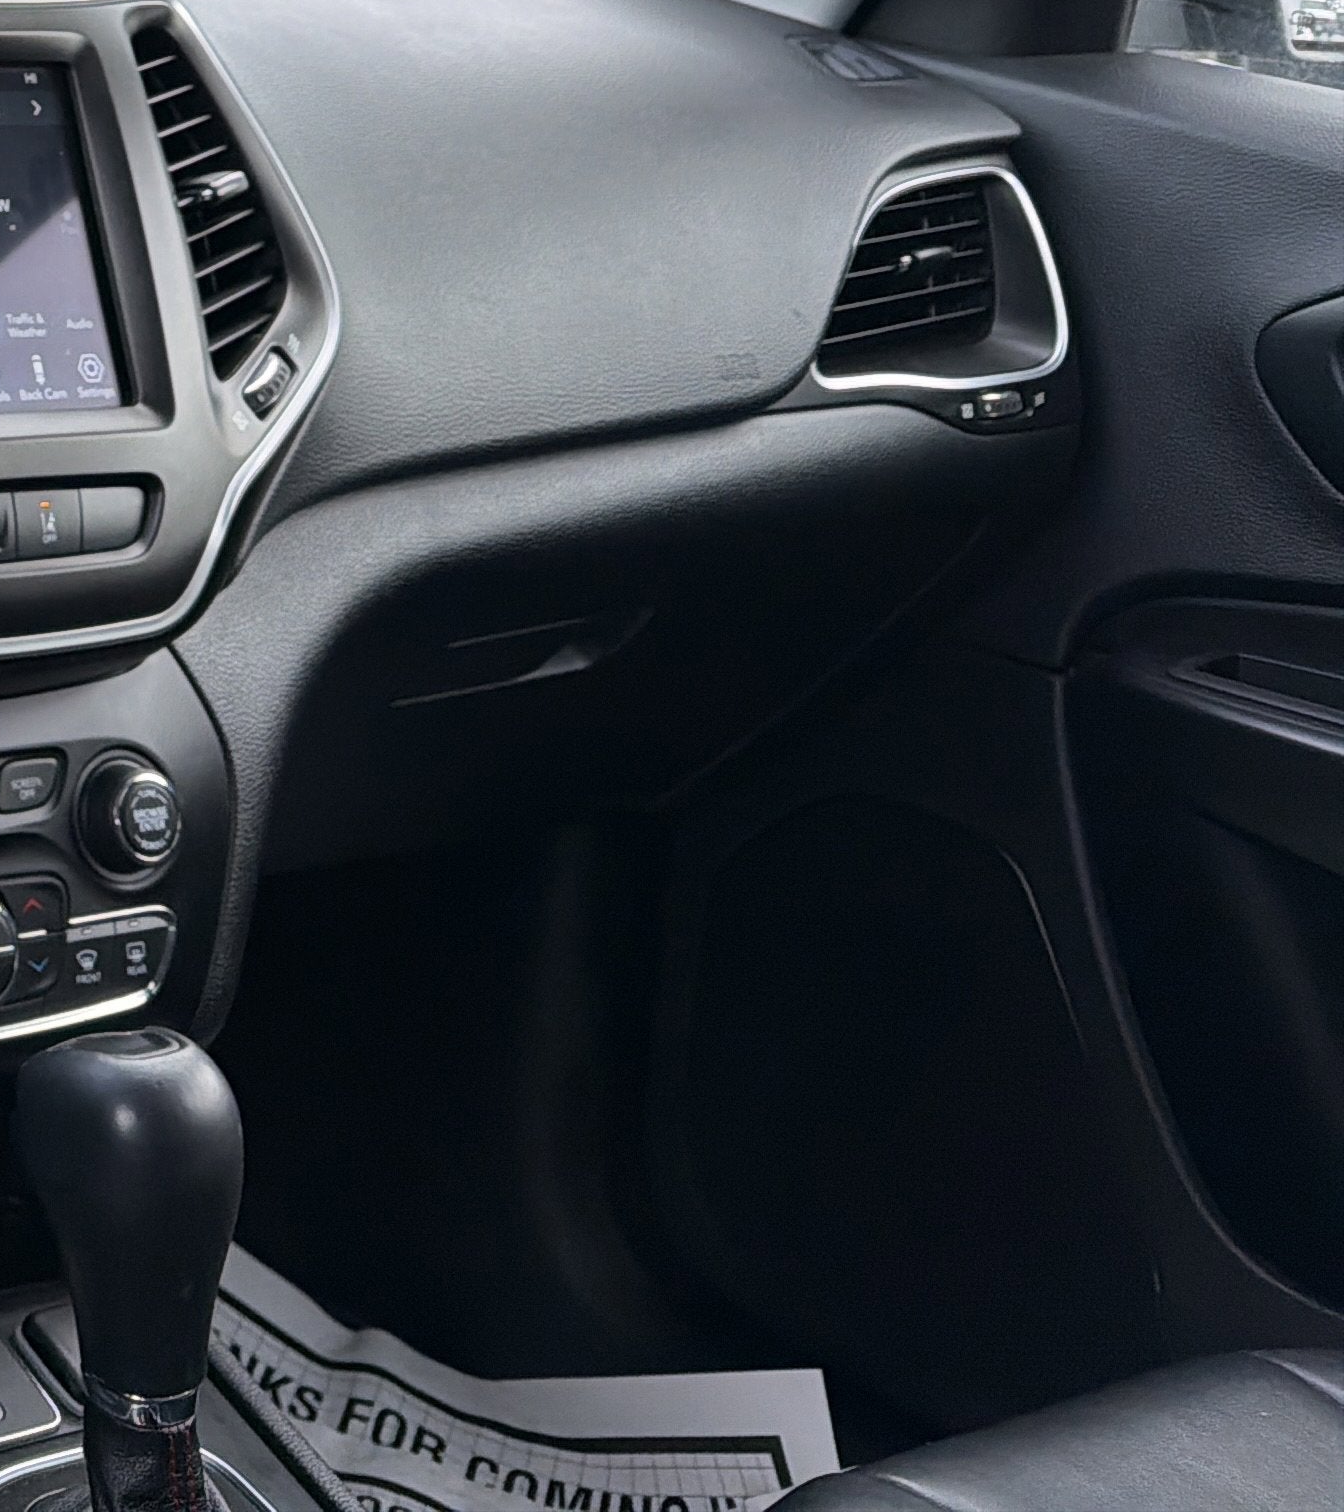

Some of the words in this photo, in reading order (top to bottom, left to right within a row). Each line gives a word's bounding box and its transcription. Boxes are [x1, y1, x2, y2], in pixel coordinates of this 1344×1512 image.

[19, 389, 43, 401] Back
[44, 388, 68, 400] Cam
[126, 963, 148, 976] REAR
[75, 971, 102, 984] FRONT
[337, 1397, 447, 1464] FOR
